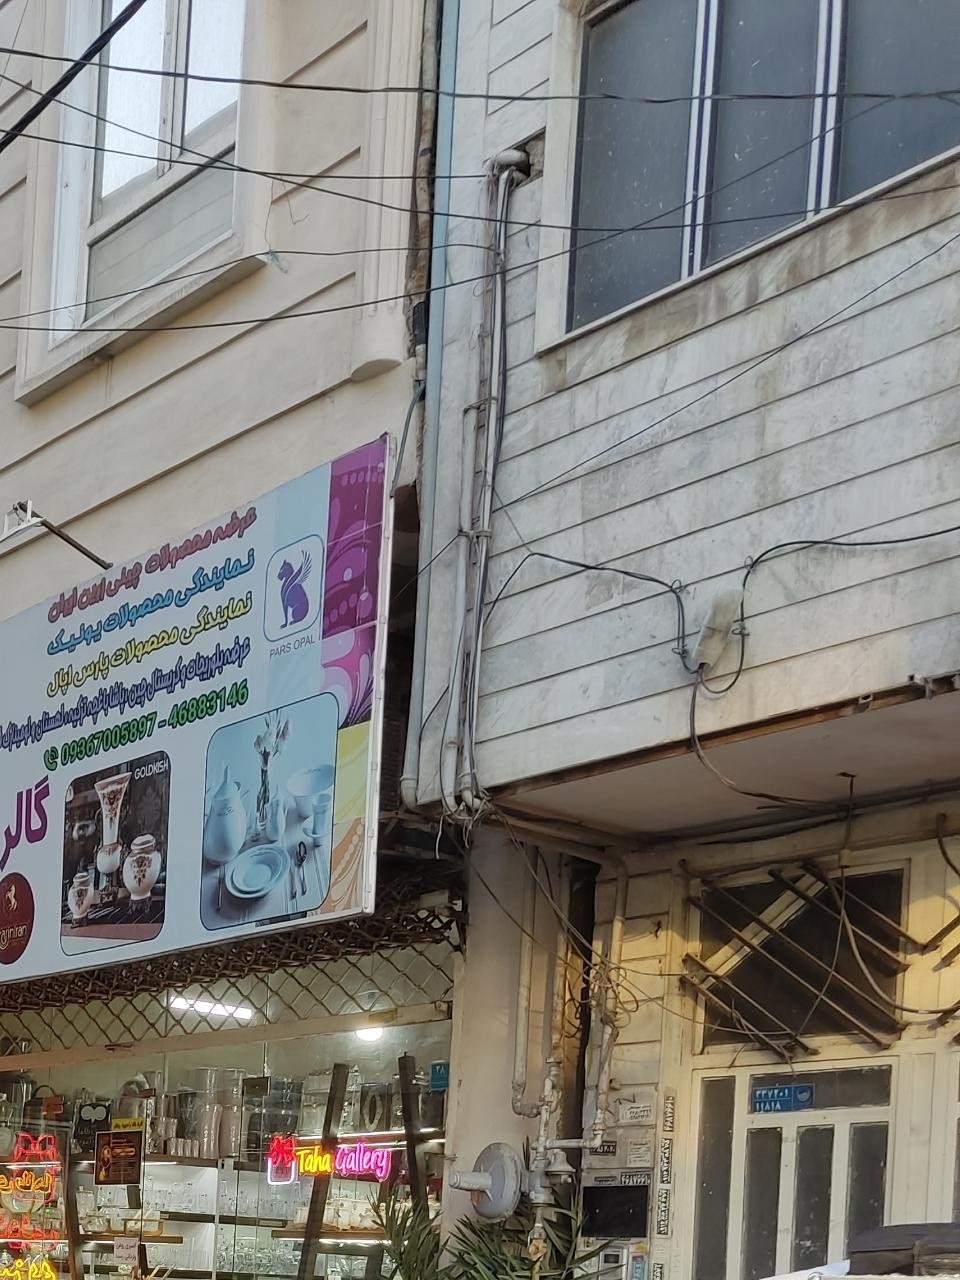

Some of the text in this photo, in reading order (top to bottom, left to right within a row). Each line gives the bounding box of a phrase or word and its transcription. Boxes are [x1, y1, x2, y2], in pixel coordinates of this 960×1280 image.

[212, 507, 257, 538] عرضه
[145, 530, 212, 574] محصولات
[47, 548, 255, 655] نمایندگی محصولات یونیک
[47, 591, 253, 698] نمایندگی محصولات پارس اپال
[221, 636, 250, 668] عرضه
[269, 635, 315, 660] PARS OPAL
[147, 656, 182, 701] کریستال
[60, 711, 158, 766] 09367005897
[167, 679, 249, 729] 46883146
[133, 759, 169, 780] GOLDKISH
[296, 1141, 391, 1182] Taha Gallery
